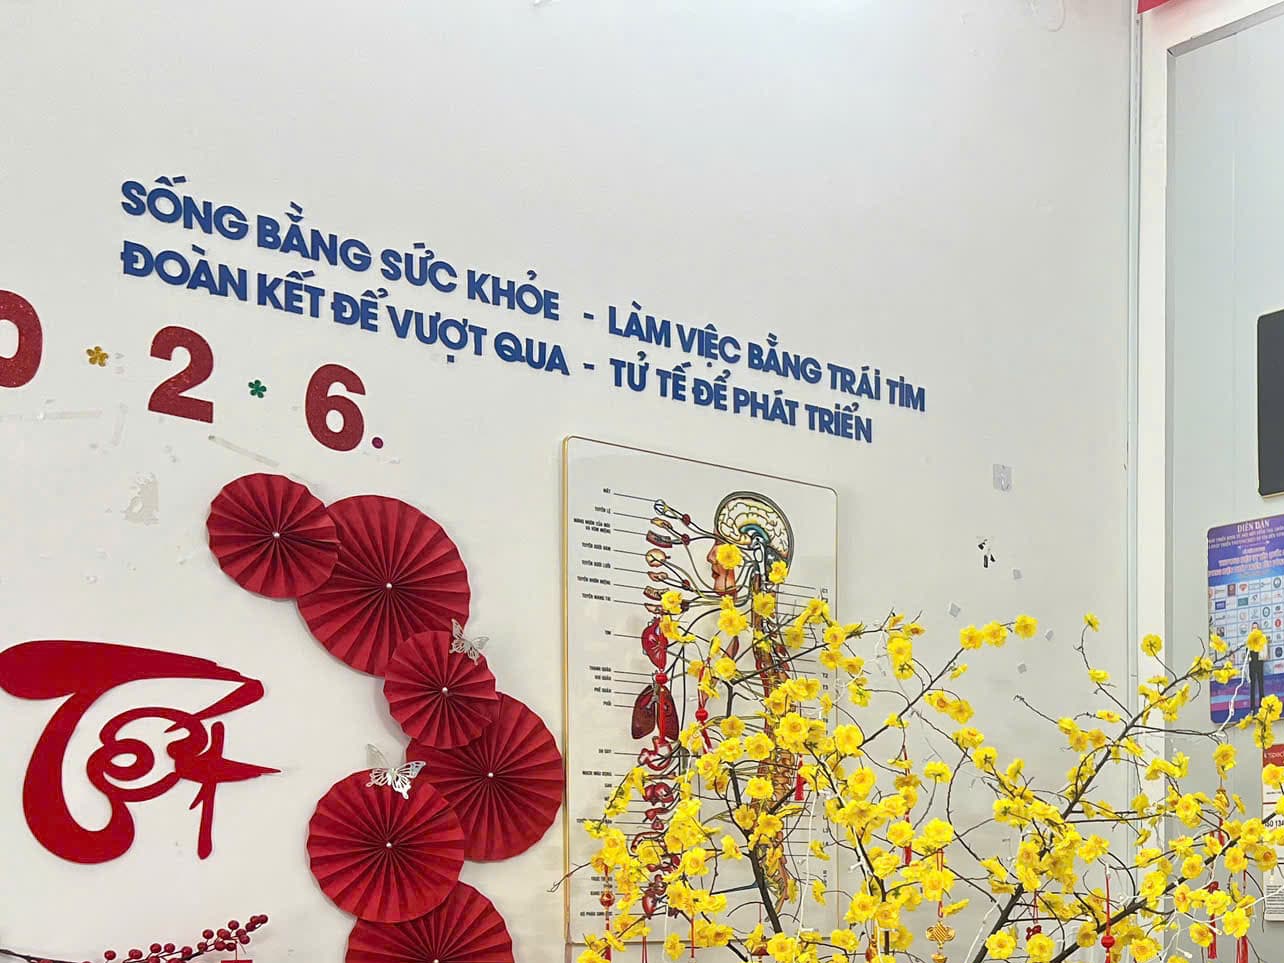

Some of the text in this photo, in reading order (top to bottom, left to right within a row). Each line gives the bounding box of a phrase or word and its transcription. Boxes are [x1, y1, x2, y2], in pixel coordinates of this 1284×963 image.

[121, 175, 249, 240] SỐNG
[257, 201, 372, 272] BẰNG
[380, 242, 457, 293] SỨC
[467, 270, 559, 321] KHỎE
[608, 300, 671, 348] LÀM
[676, 323, 741, 368] VIỆC
[748, 332, 822, 384] BẰNG
[827, 365, 881, 402] TRÁI
[121, 240, 872, 443] ĐOÀN KẾT ĐỂ VƯỢT QUA TỬ TẾ ĐỂ PHÁT TRIỂN
[147, 325, 214, 424] 2
